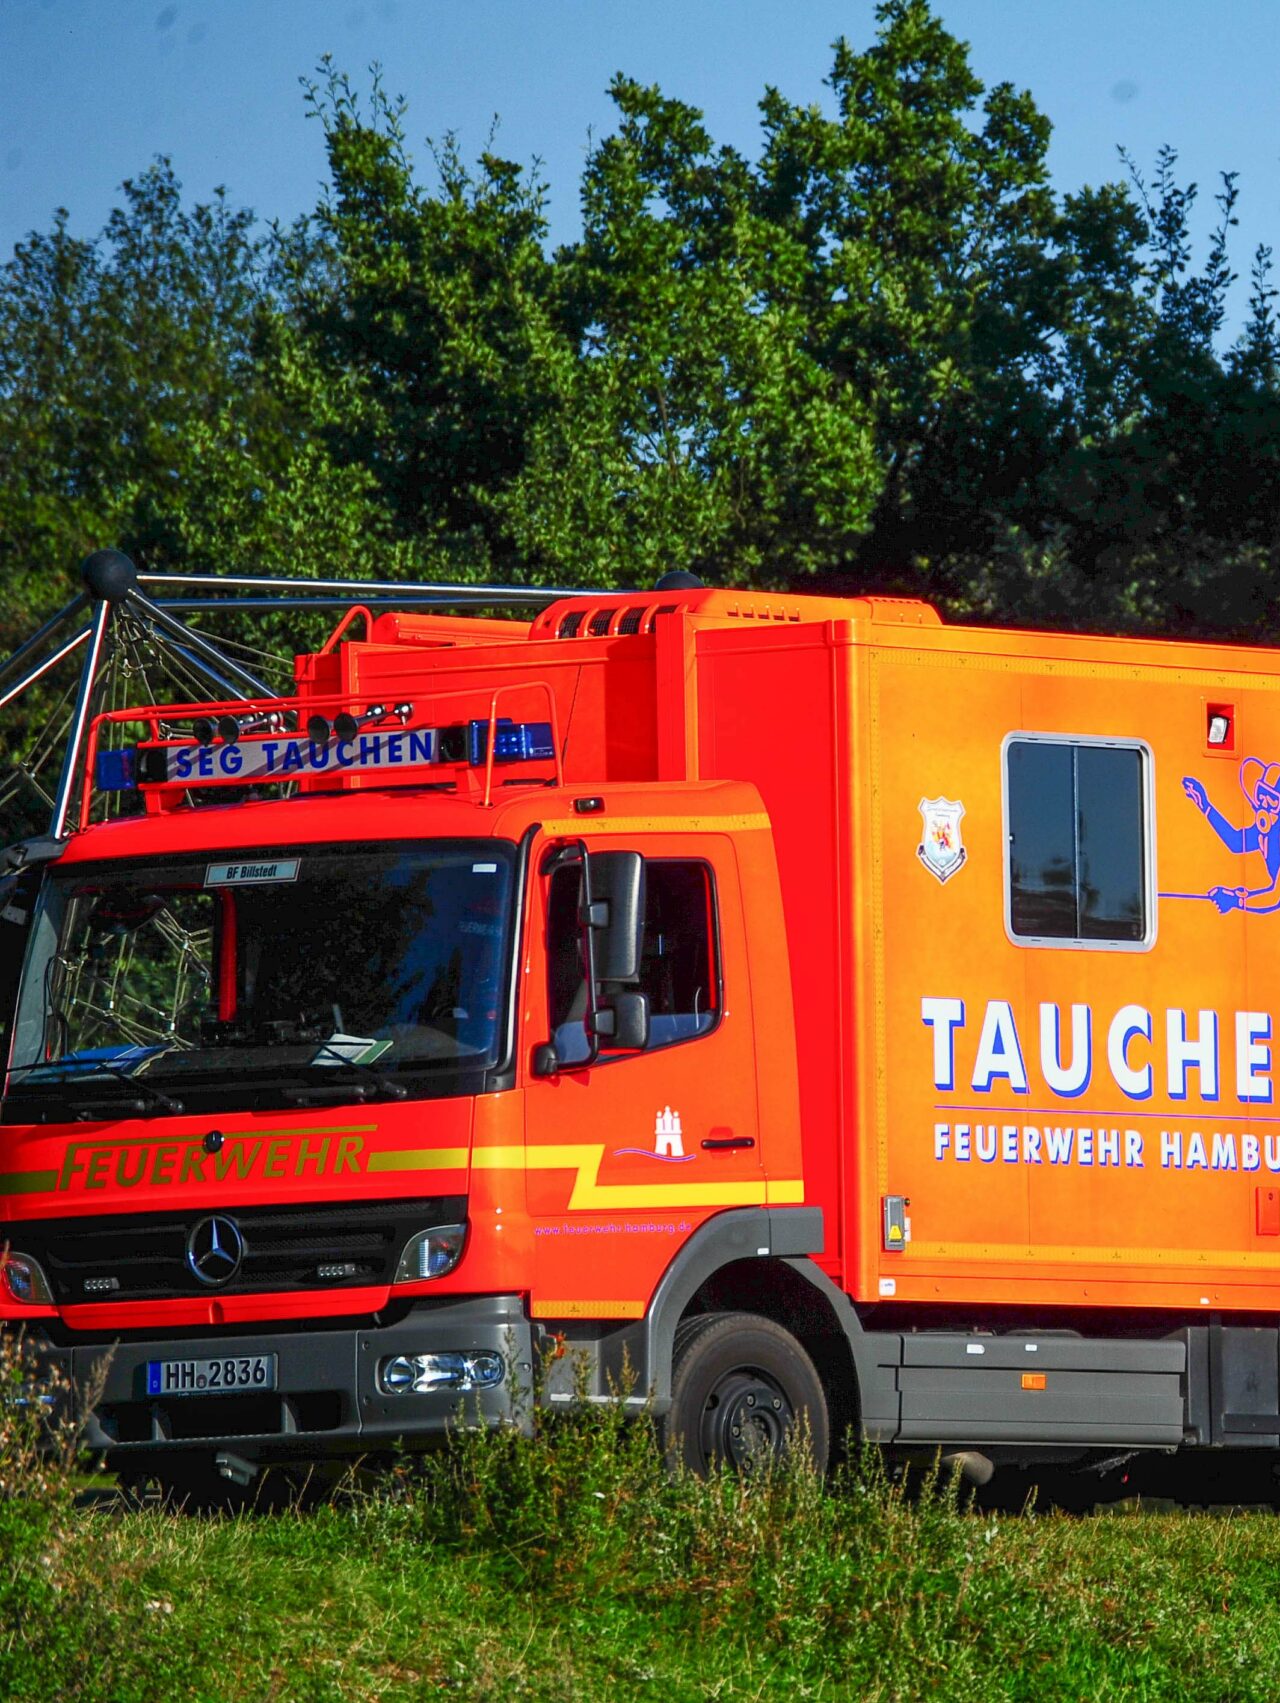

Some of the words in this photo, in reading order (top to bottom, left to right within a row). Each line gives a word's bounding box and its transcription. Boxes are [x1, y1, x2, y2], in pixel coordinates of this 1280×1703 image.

[176, 744, 243, 778] SEG
[262, 732, 433, 772] TAUCHEN
[226, 866, 239, 879] BF
[241, 864, 278, 878] Billstedt
[58, 1135, 366, 1191] FEUERWEHR
[934, 1122, 1145, 1169] FEUERWEHR
[166, 1363, 195, 1389] HH
[209, 1358, 266, 1387] 2836
